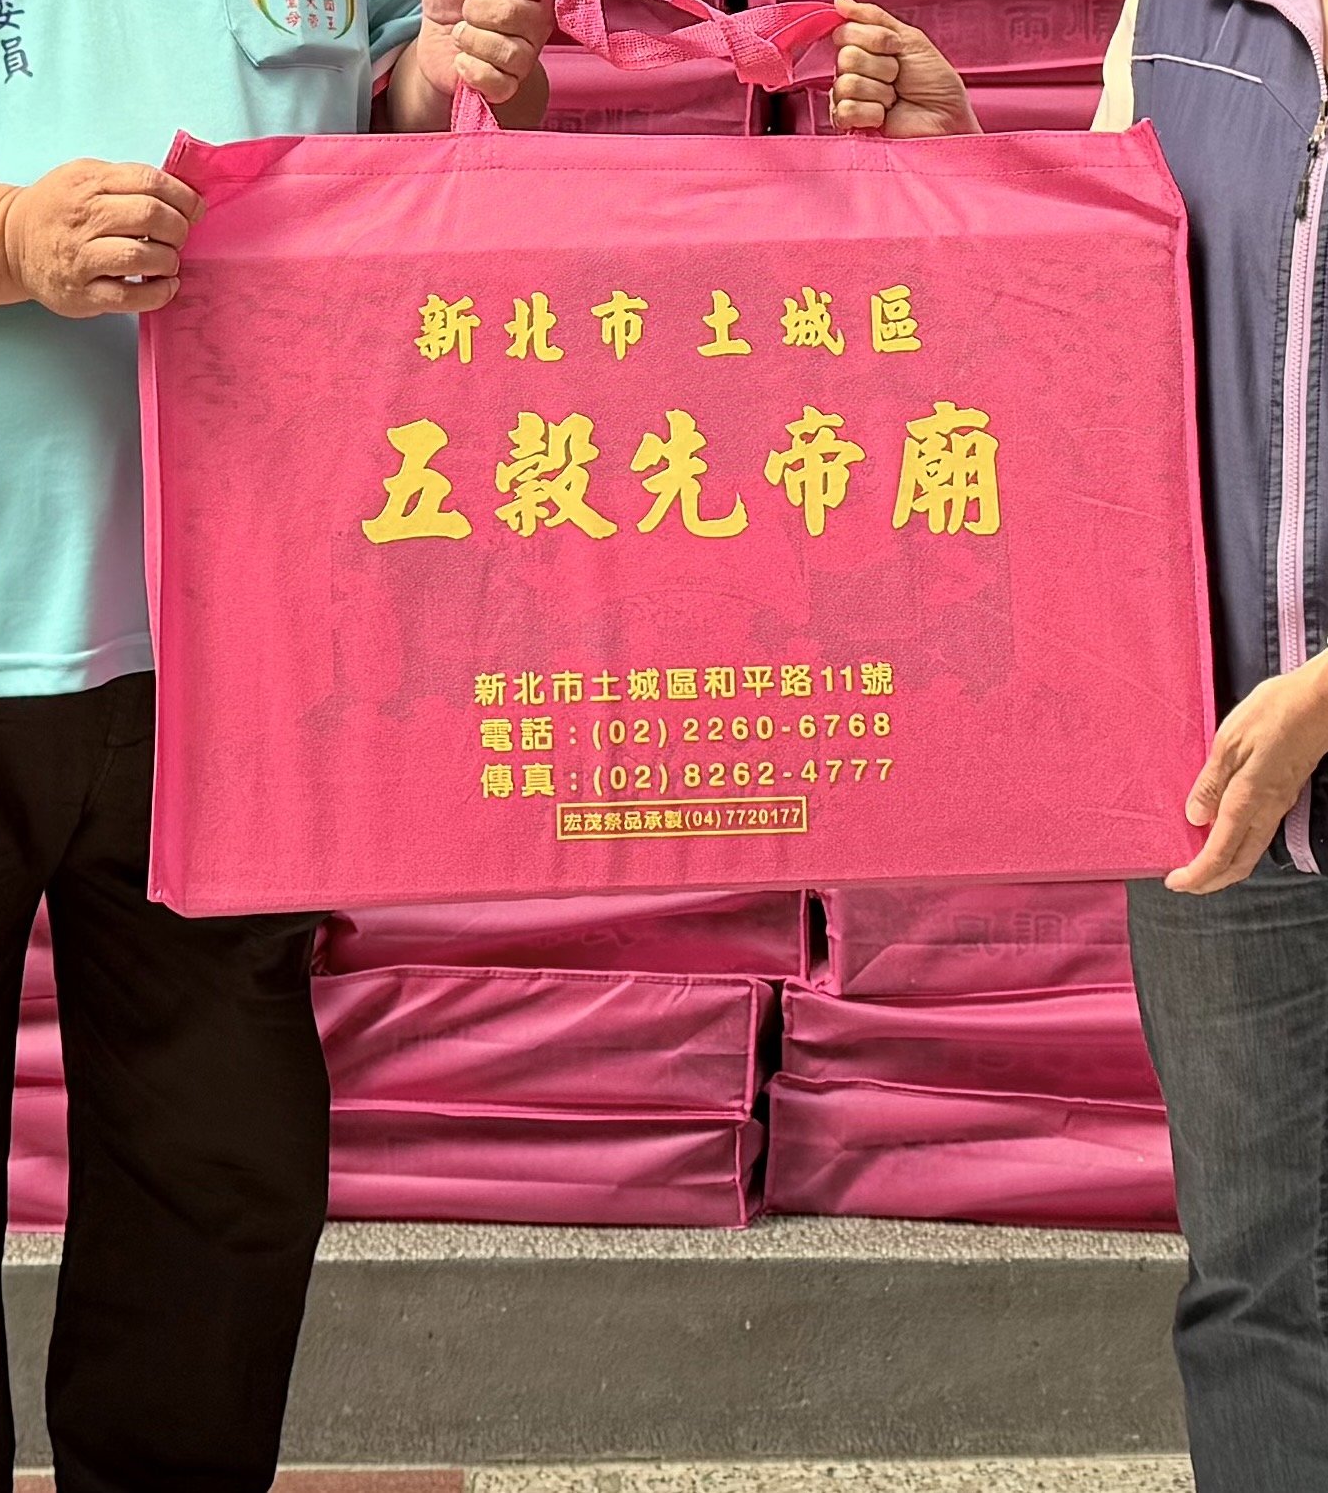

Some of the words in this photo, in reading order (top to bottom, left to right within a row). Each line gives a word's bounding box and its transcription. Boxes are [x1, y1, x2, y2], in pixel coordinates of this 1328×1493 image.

[360, 399, 1002, 546] 五穀先帝廟
[473, 661, 895, 708] 新北市土城區和平路11號
